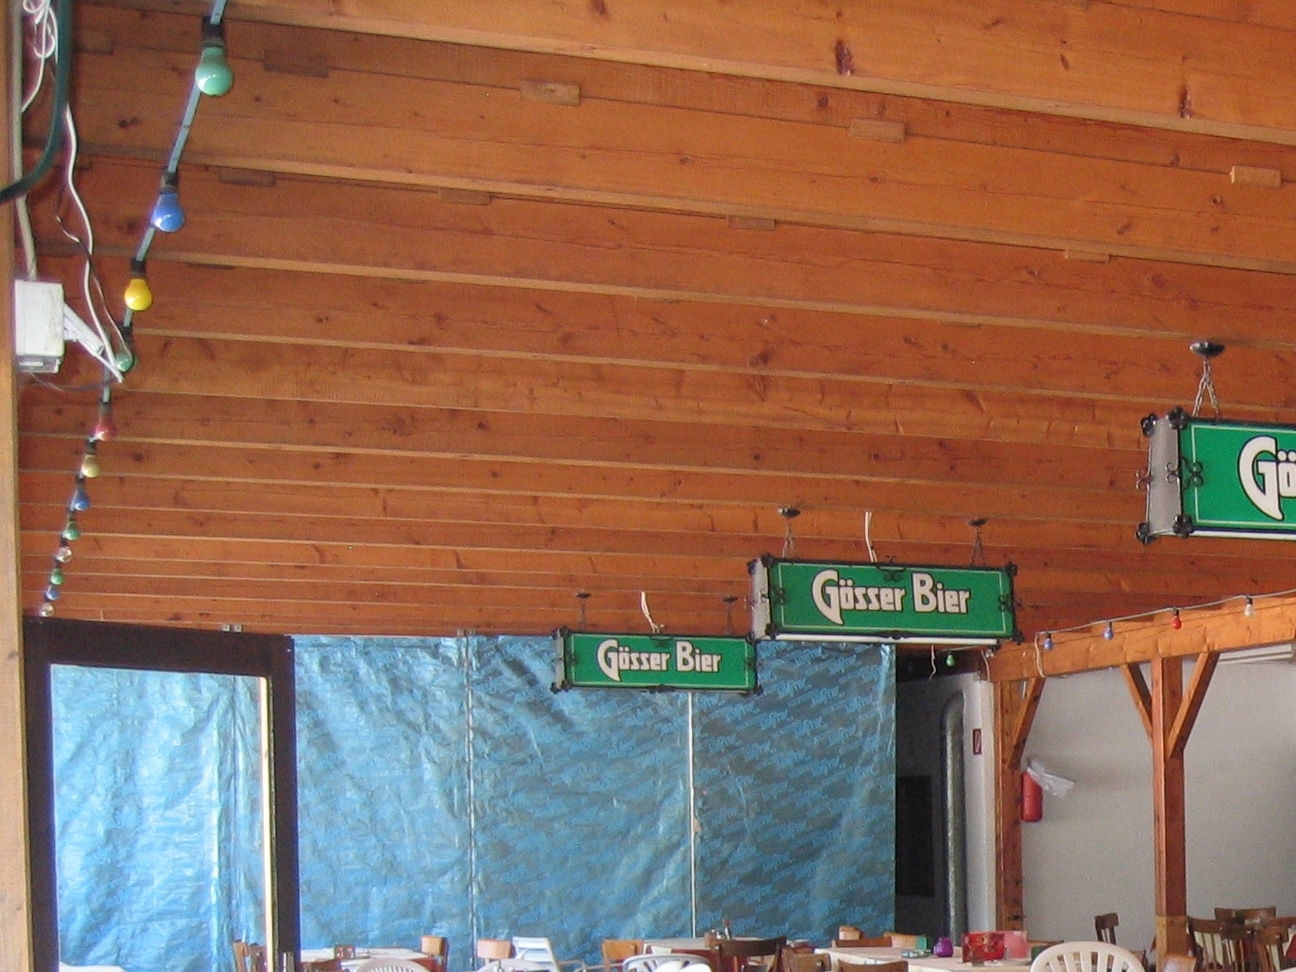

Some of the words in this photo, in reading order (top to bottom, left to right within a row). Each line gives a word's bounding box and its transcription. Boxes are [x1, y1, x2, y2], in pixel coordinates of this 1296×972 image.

[812, 569, 906, 625] Gösser
[912, 572, 970, 614] Bier
[597, 639, 671, 682] Gösser
[676, 640, 722, 673] Bier
